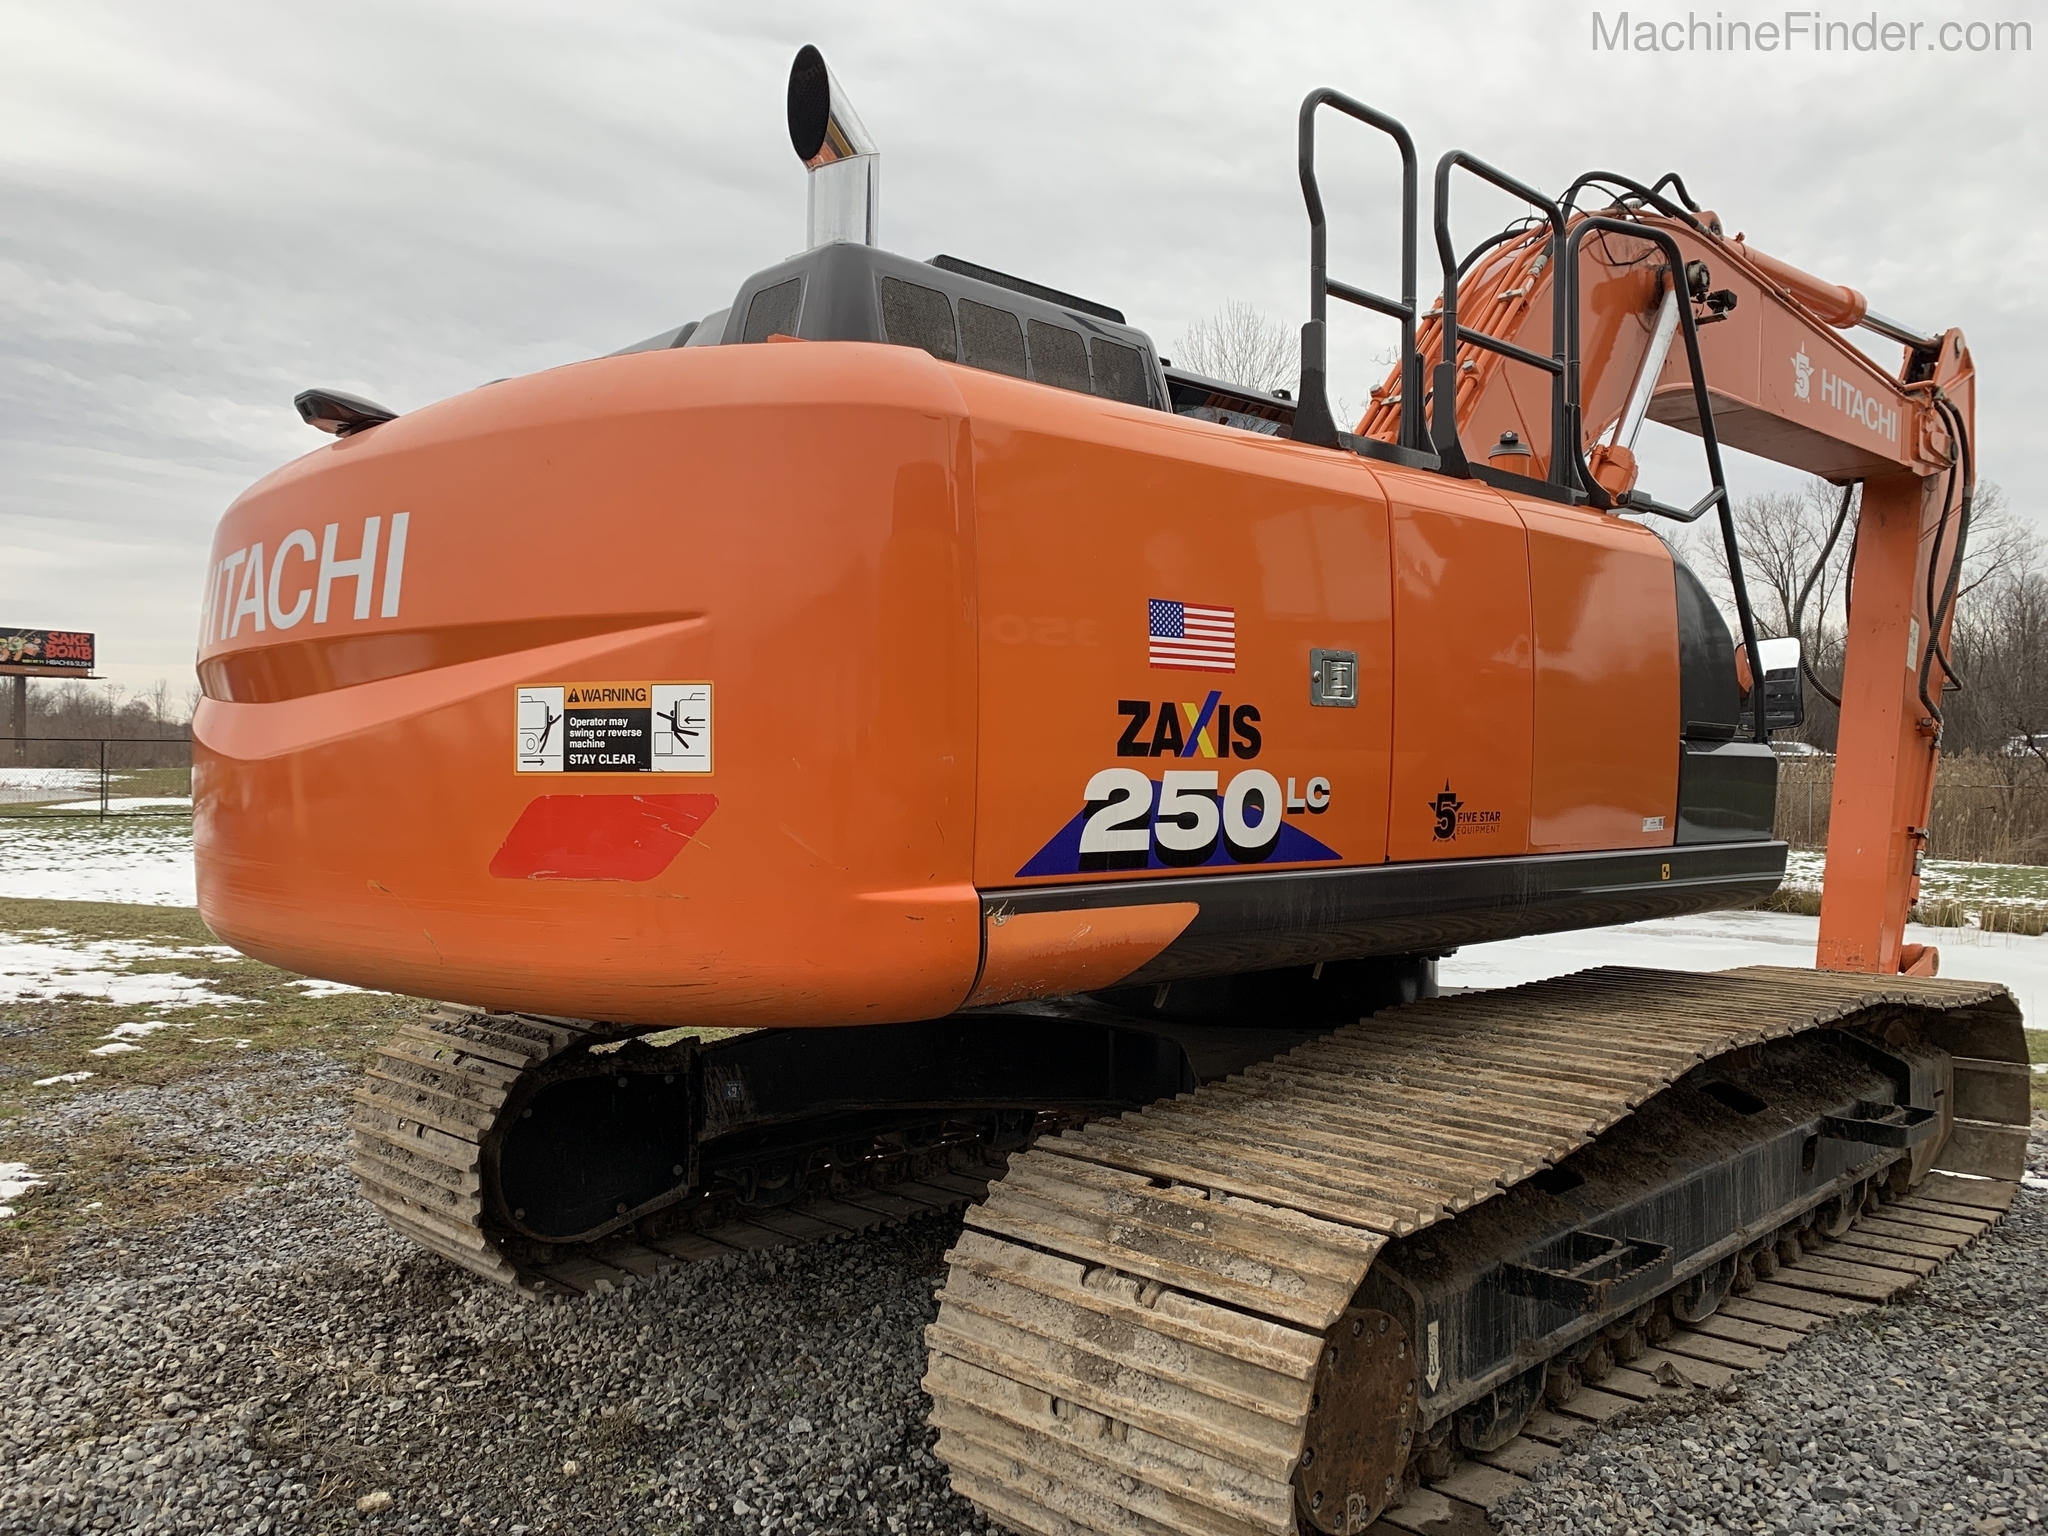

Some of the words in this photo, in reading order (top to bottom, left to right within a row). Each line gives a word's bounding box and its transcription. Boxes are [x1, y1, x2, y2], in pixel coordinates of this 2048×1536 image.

[1795, 351, 1810, 399] 5
[1821, 368, 1897, 443] HITACHI
[47, 631, 90, 647] SAKE
[45, 644, 92, 660] BOMB
[581, 688, 647, 702] WARNING
[569, 717, 607, 728] Operator
[609, 718, 628, 728] may
[1116, 690, 1262, 760] ZAXIS
[569, 728, 594, 740] swing
[596, 729, 606, 737] or
[608, 729, 642, 737] reverse
[569, 739, 605, 748] machine
[569, 754, 596, 765] STAY
[599, 753, 636, 765] CLEAR
[1079, 767, 1283, 866] 250
[1286, 777, 1331, 814] LC
[1434, 792, 1457, 839] 5
[1457, 811, 1477, 823] FIVE
[1479, 811, 1501, 823] STAR
[1457, 825, 1500, 835] EQUIPMENT
